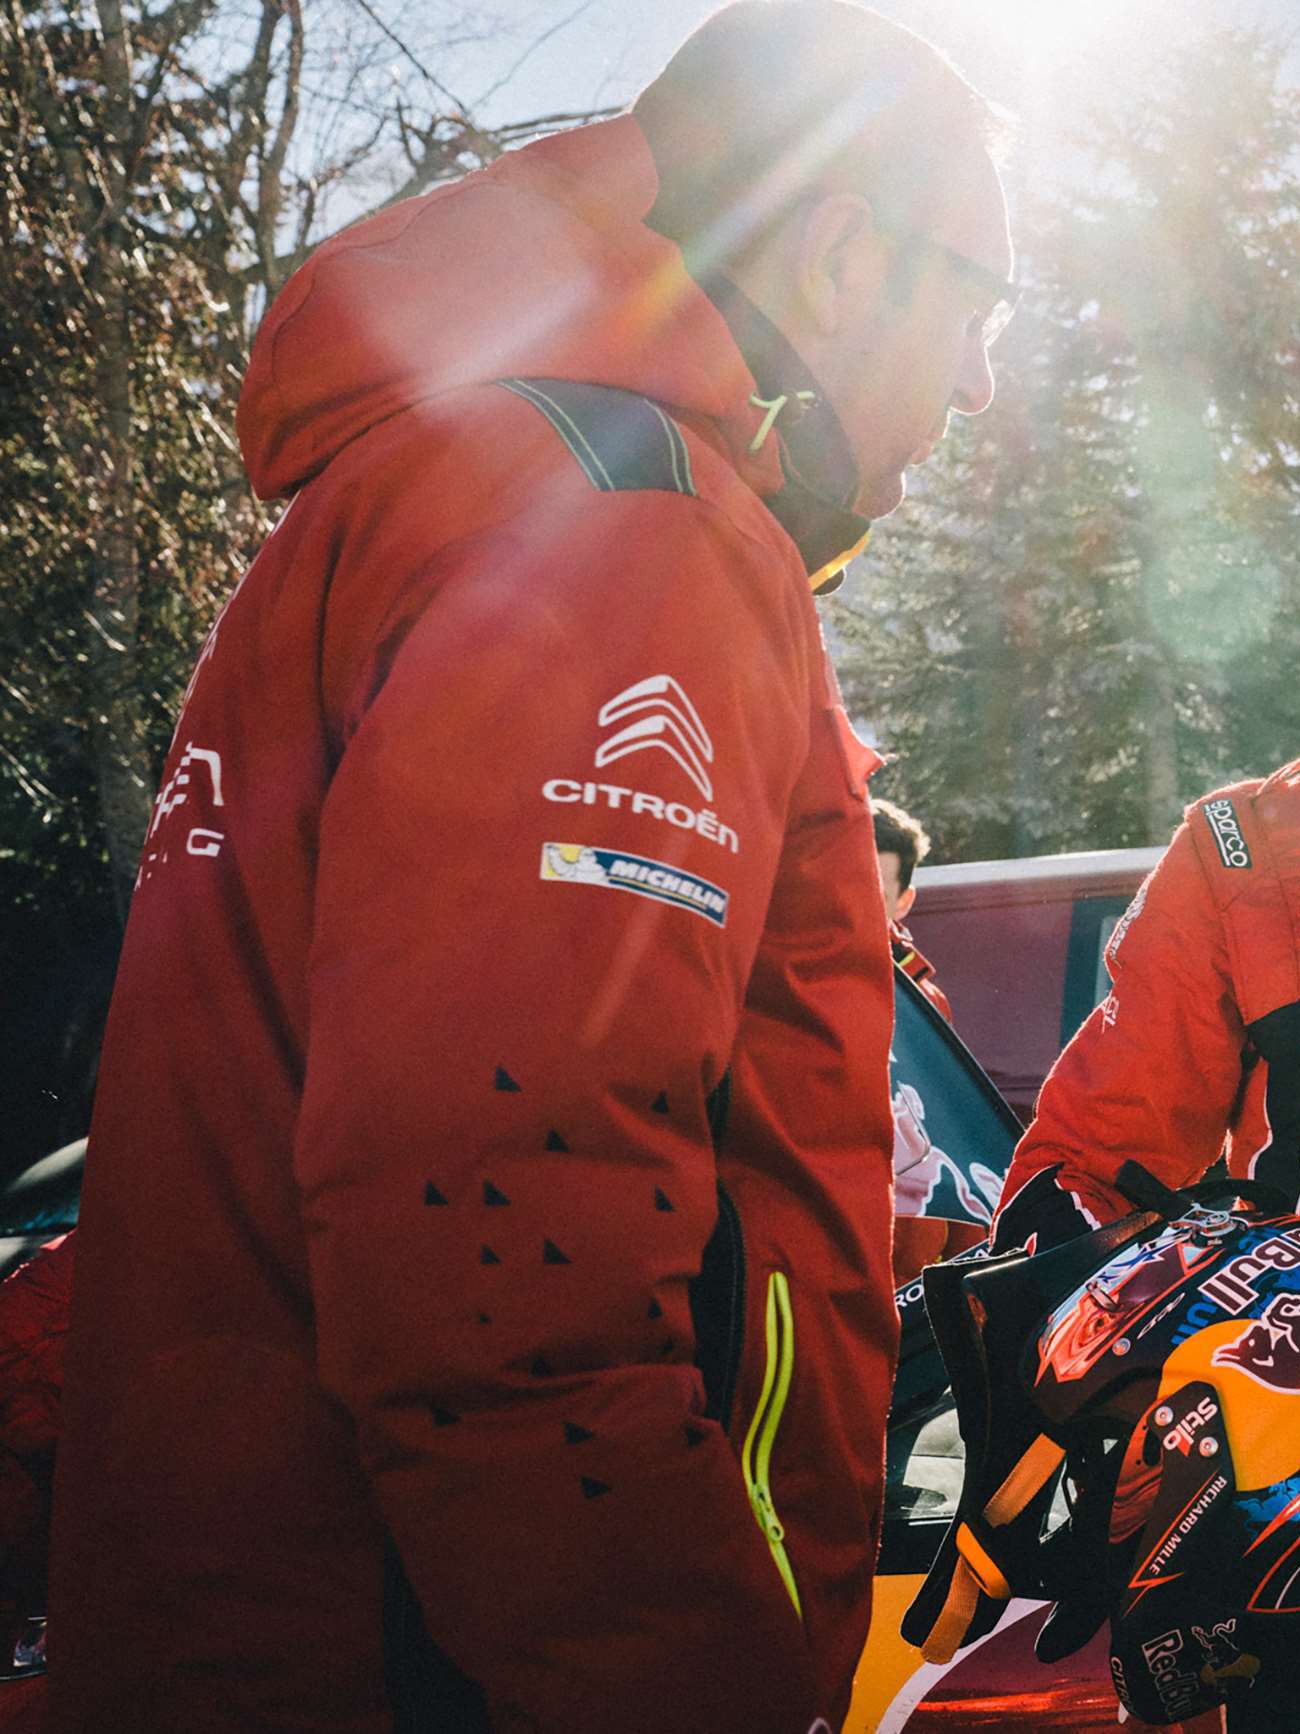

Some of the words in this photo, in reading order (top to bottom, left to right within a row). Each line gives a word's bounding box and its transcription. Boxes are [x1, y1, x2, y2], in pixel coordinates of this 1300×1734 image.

[1205, 800, 1249, 867] sparco
[609, 859, 728, 914] MICHELIN
[1163, 1397, 1218, 1450] Stilo
[1179, 1475, 1228, 1534] RICHARD
[1149, 1533, 1182, 1576] MILLE
